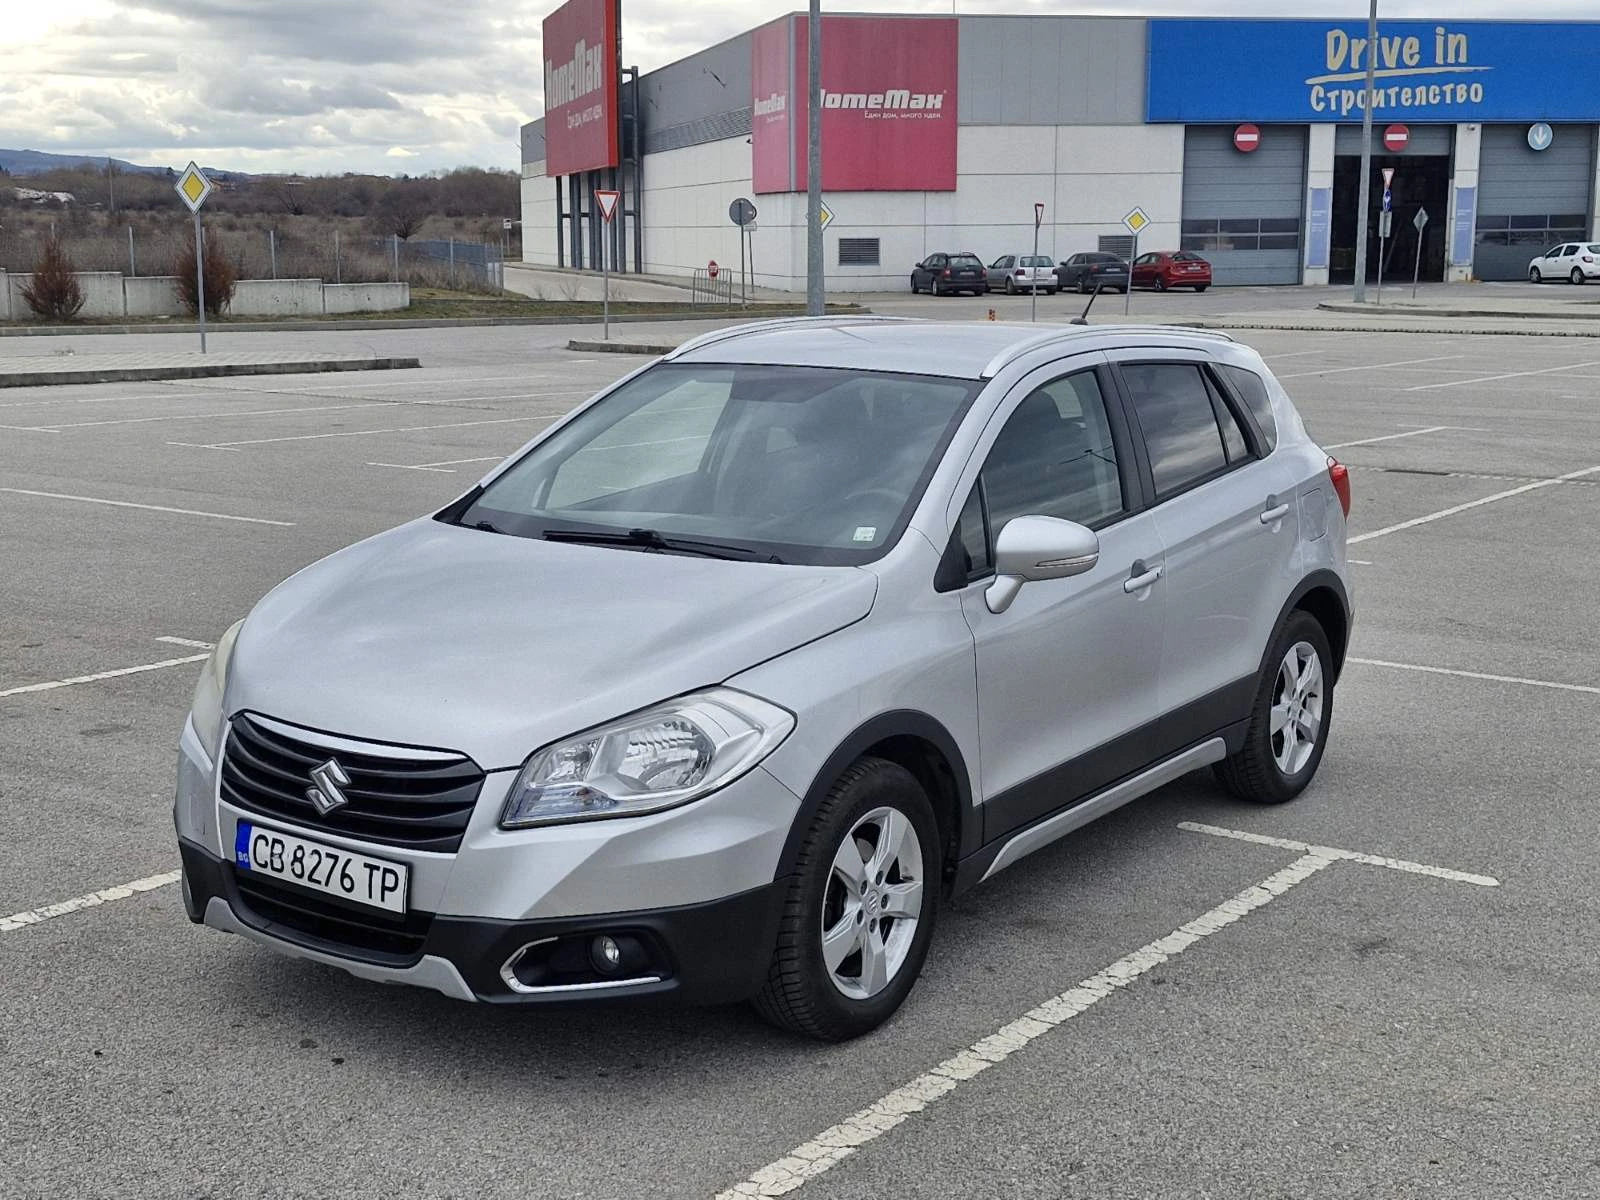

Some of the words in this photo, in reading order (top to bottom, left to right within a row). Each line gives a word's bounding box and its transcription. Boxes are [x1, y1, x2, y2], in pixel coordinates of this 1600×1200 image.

[1435, 26, 1467, 65] in
[545, 37, 602, 112] HomeMax
[1310, 83, 1483, 116] Строителство
[237, 851, 249, 863] BG
[253, 834, 285, 873] CB
[291, 845, 355, 893] 8276
[363, 862, 399, 902] TP
